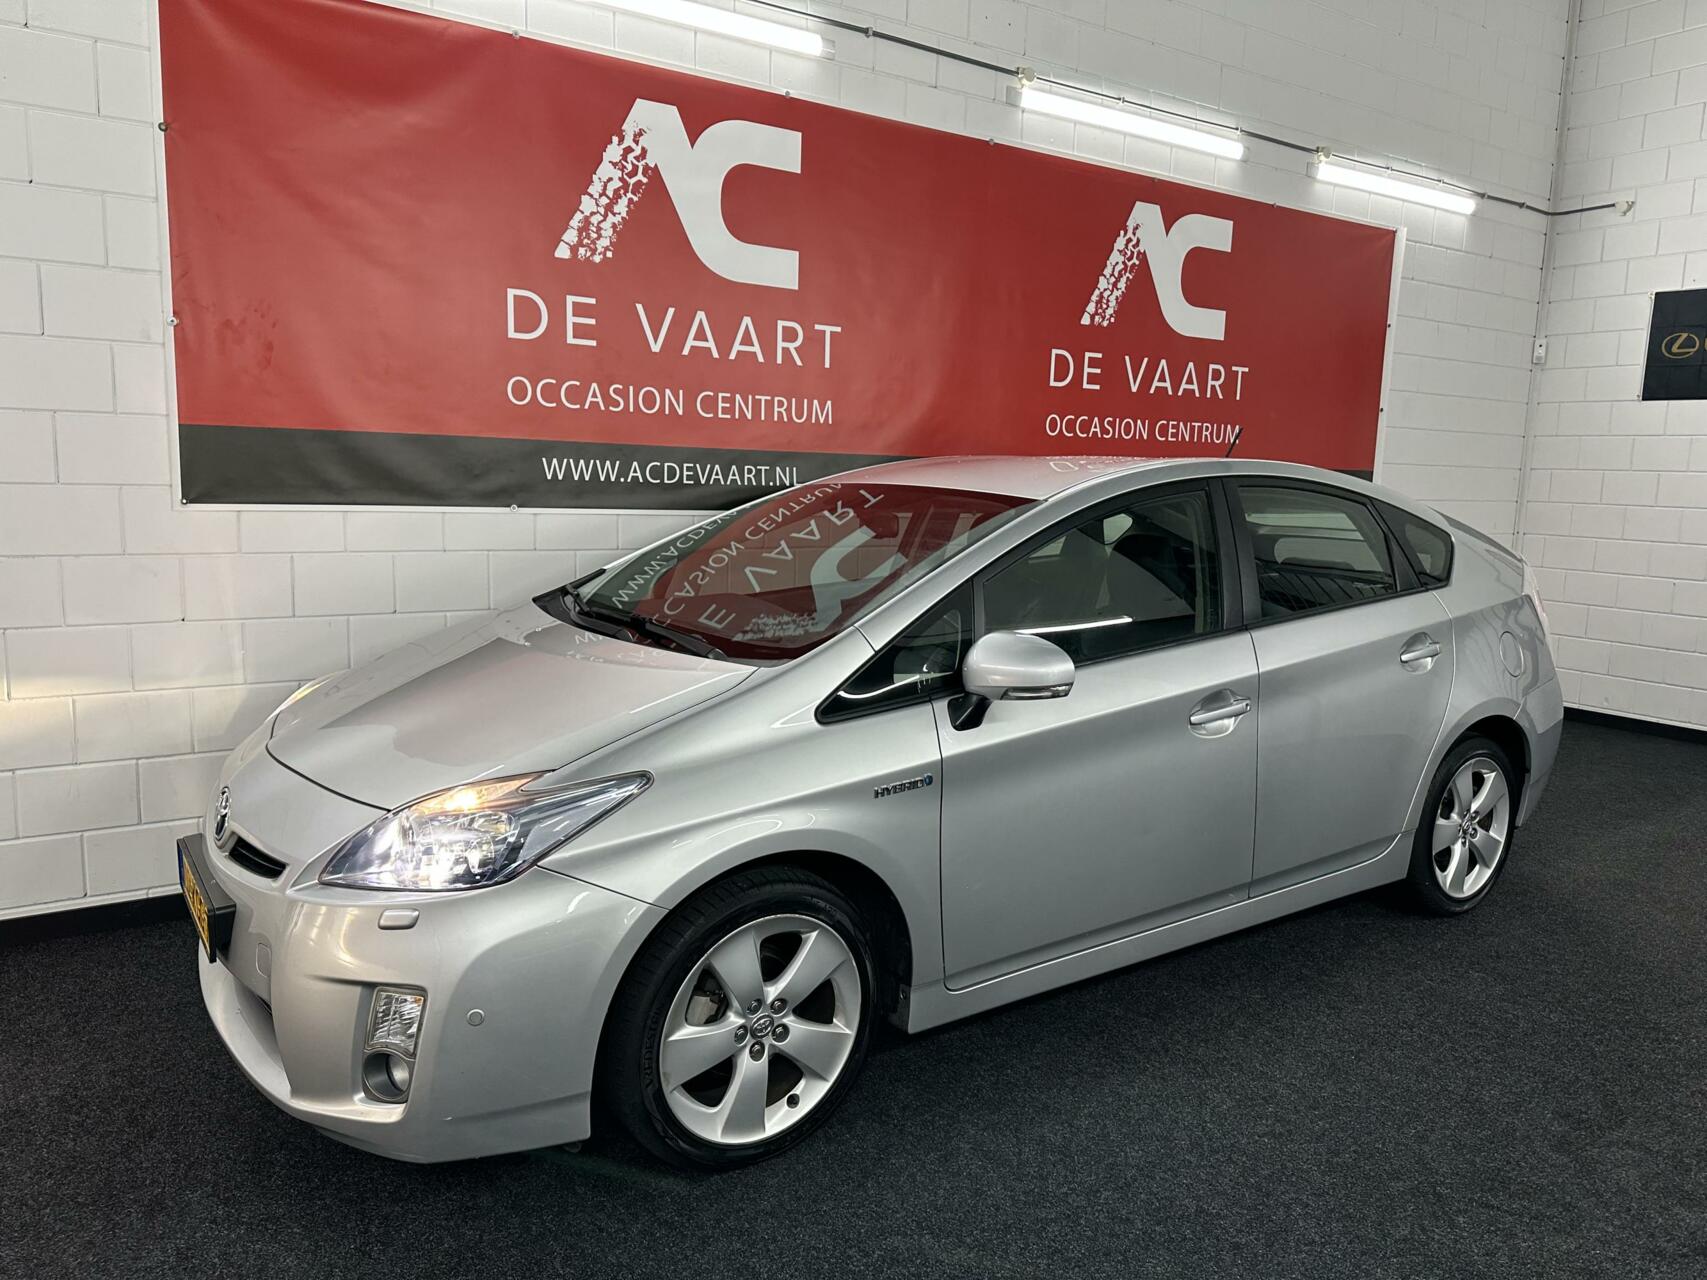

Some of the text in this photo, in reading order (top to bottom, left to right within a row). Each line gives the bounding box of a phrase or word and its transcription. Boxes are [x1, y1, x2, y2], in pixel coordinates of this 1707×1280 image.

[554, 97, 803, 291] AC
[1080, 200, 1234, 341] AC
[506, 287, 842, 369] DE VAART
[506, 375, 833, 425] OCCASION CENTRUM
[1049, 348, 1249, 401] DE VAART
[1045, 413, 1240, 444] OCCASION CENTRUM
[541, 457, 802, 487] WWW.ACDEVAART.NL
[873, 777, 924, 799] HYBRID
